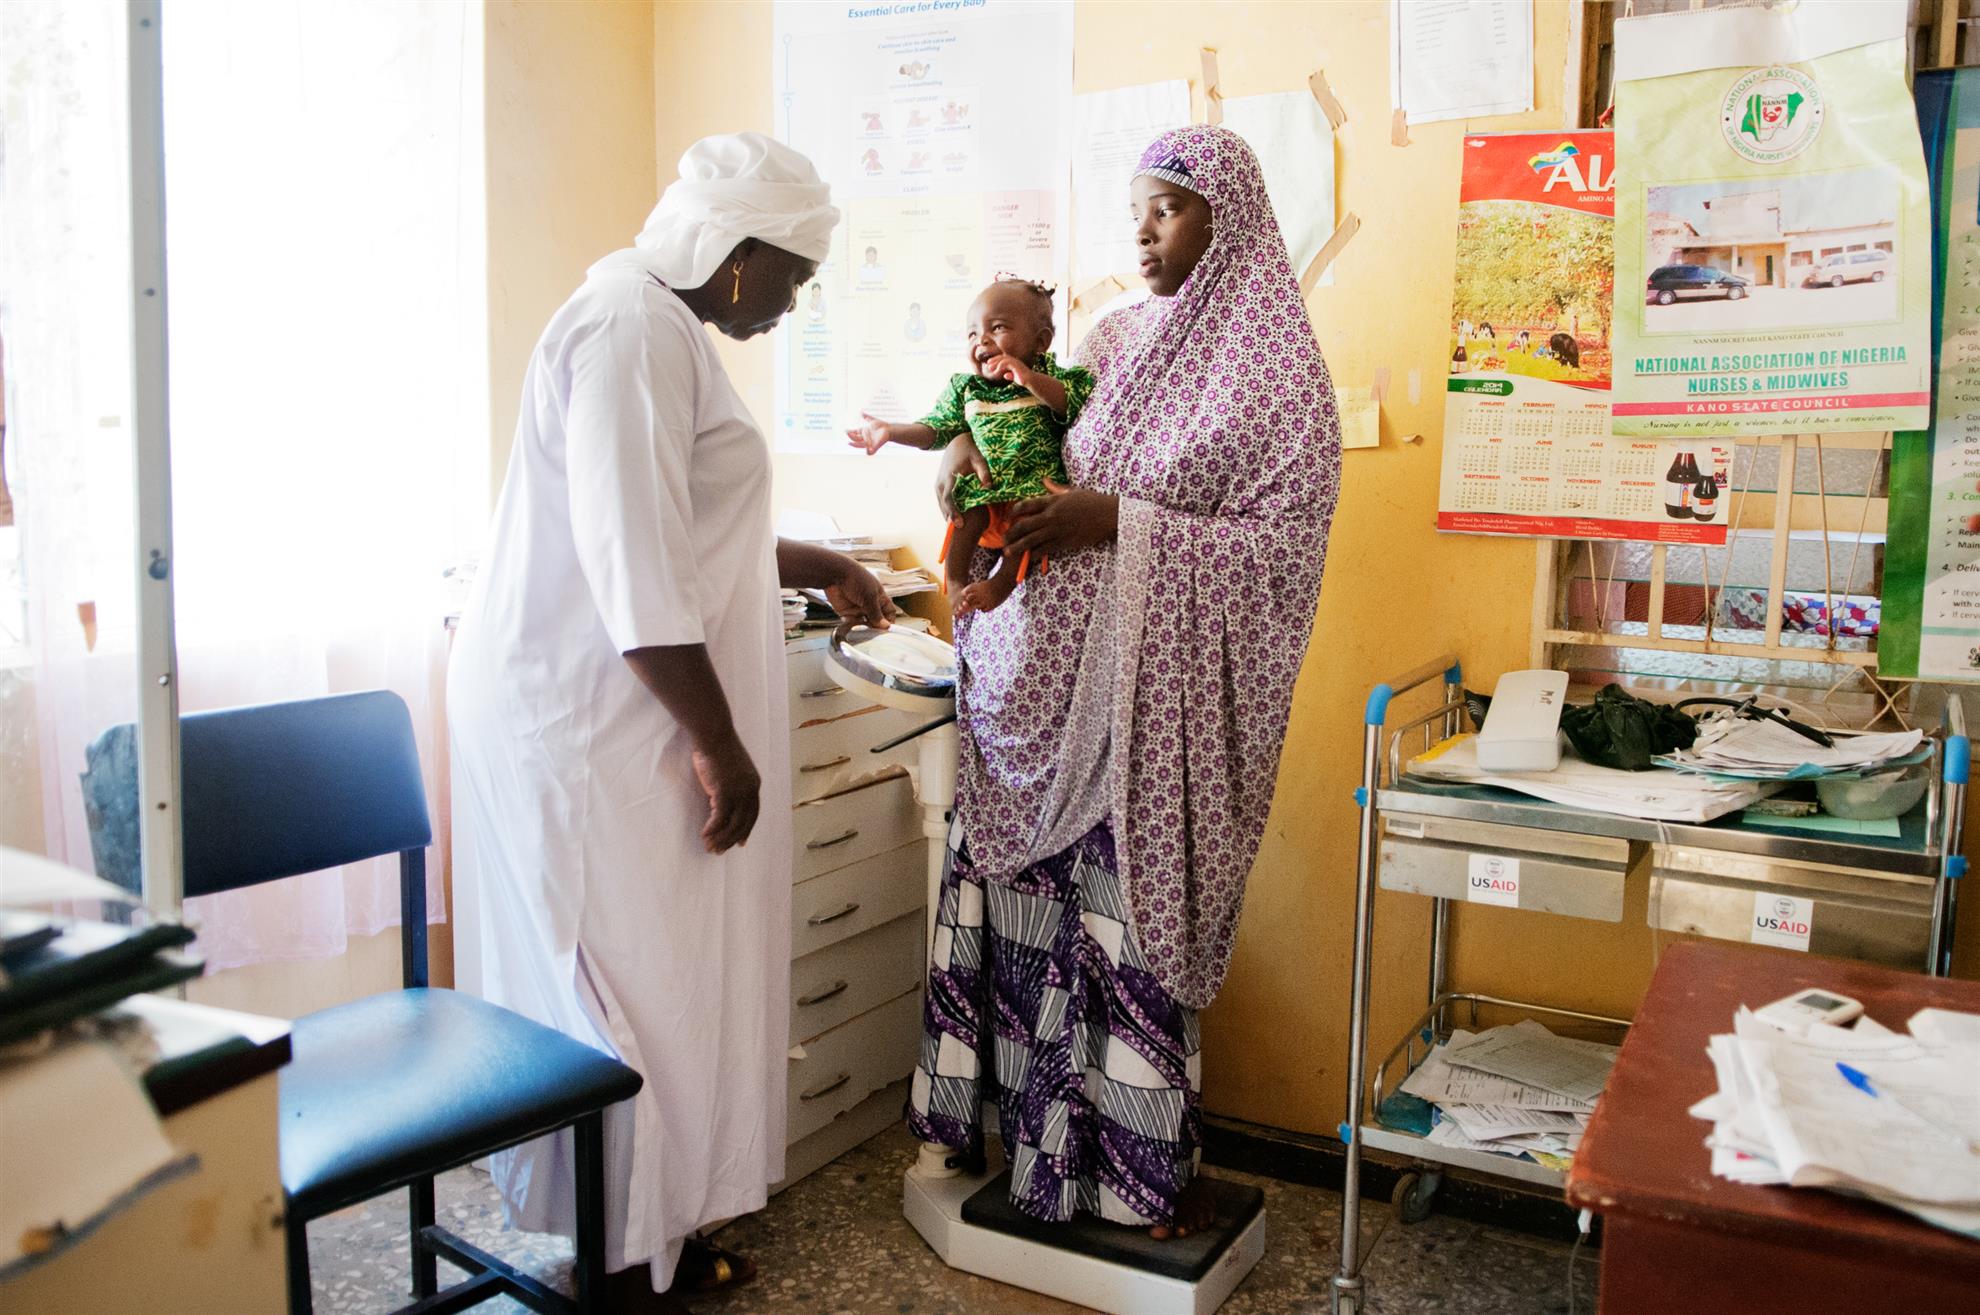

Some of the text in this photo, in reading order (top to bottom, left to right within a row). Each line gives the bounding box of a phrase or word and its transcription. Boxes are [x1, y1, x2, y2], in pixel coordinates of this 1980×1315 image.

[848, 6, 892, 18] Essential
[894, 4, 916, 14] Care
[917, 2, 930, 12] for
[933, 0, 960, 10] Every
[1727, 69, 1820, 111] NATIONAL ASSOCIATION
[1959, 328, 1978, 336] Give
[1635, 346, 1907, 373] NATIONAL ASSOCIATION OF NIGERIA
[1688, 372, 1849, 393] NURSES & MIDWIVES
[1687, 398, 1849, 412] KANO STATE COUNCIL
[1472, 877, 1516, 891] USAID
[1757, 916, 1808, 934] USAID
